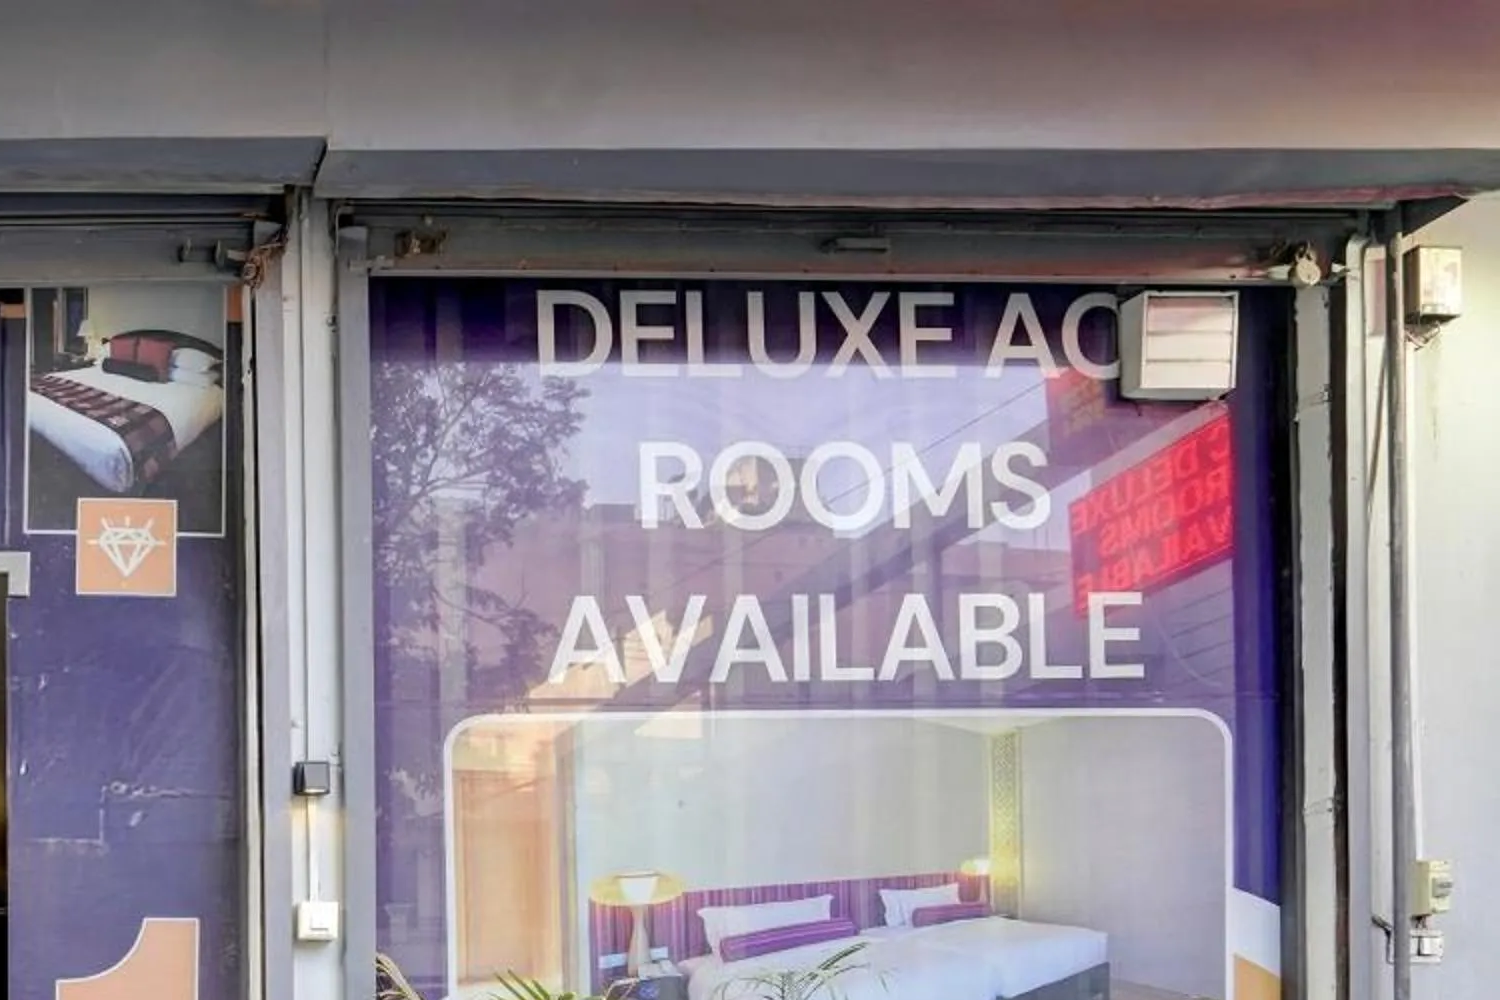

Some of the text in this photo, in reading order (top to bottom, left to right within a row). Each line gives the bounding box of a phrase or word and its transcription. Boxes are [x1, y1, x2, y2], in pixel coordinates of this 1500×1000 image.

[537, 289, 1121, 380] DELUXE AC
[639, 440, 1052, 531] ROOMS
[547, 591, 1143, 683] AVAILABLE
